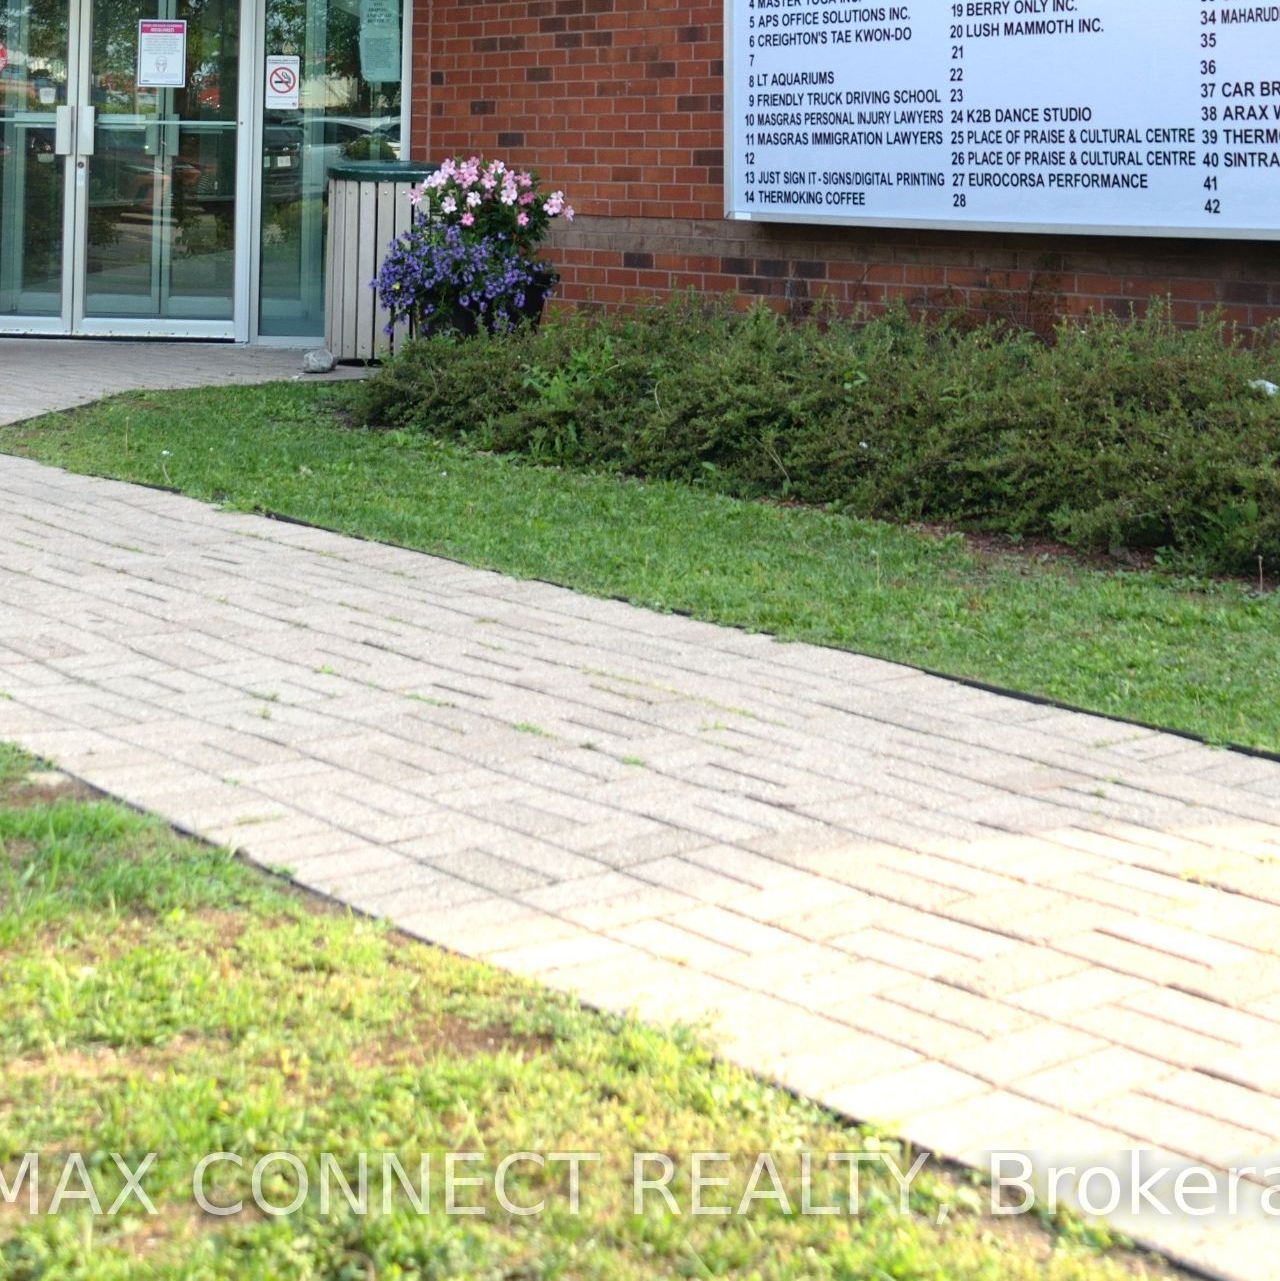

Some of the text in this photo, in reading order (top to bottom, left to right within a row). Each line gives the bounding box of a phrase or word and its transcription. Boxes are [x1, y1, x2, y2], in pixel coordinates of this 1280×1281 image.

[965, 1, 1010, 17] BERRY
[1013, 0, 1048, 14] ONLY
[757, 6, 911, 28] APS OFFICE SOLUTIONS INC.
[965, 18, 1104, 38] LUSH MAMMOTH INC.
[757, 27, 912, 47] CREIGHTON'S TAE KWON-DO
[756, 71, 835, 87] LT AQUARIUMS
[1220, 82, 1255, 97] CAR
[756, 89, 942, 107] FRIENDLY TRUCK DRIVING SCHOOL
[756, 110, 944, 126] MASGRAS PERSONAL INJURY LAWYERS
[966, 107, 1092, 123] K2B DANCE STUDIO
[1222, 105, 1269, 121] ARAX
[757, 131, 943, 145] MASGRAS IMMIGRATION LAWYERS
[966, 128, 1195, 144] PLACE OF PRAISE & CULTURAL CENTRE
[967, 151, 1196, 166] PLACE OF PRAISE & CULTURAL CENTRE
[757, 171, 781, 184] JUST
[783, 171, 806, 185] SIGN
[895, 172, 945, 186] PRINTING
[967, 172, 1148, 189] EUROCORSA PERFORMANCE
[757, 190, 866, 206] THERMOKING COFFEE
[952, 193, 966, 208] 28
[1203, 199, 1220, 214] 42
